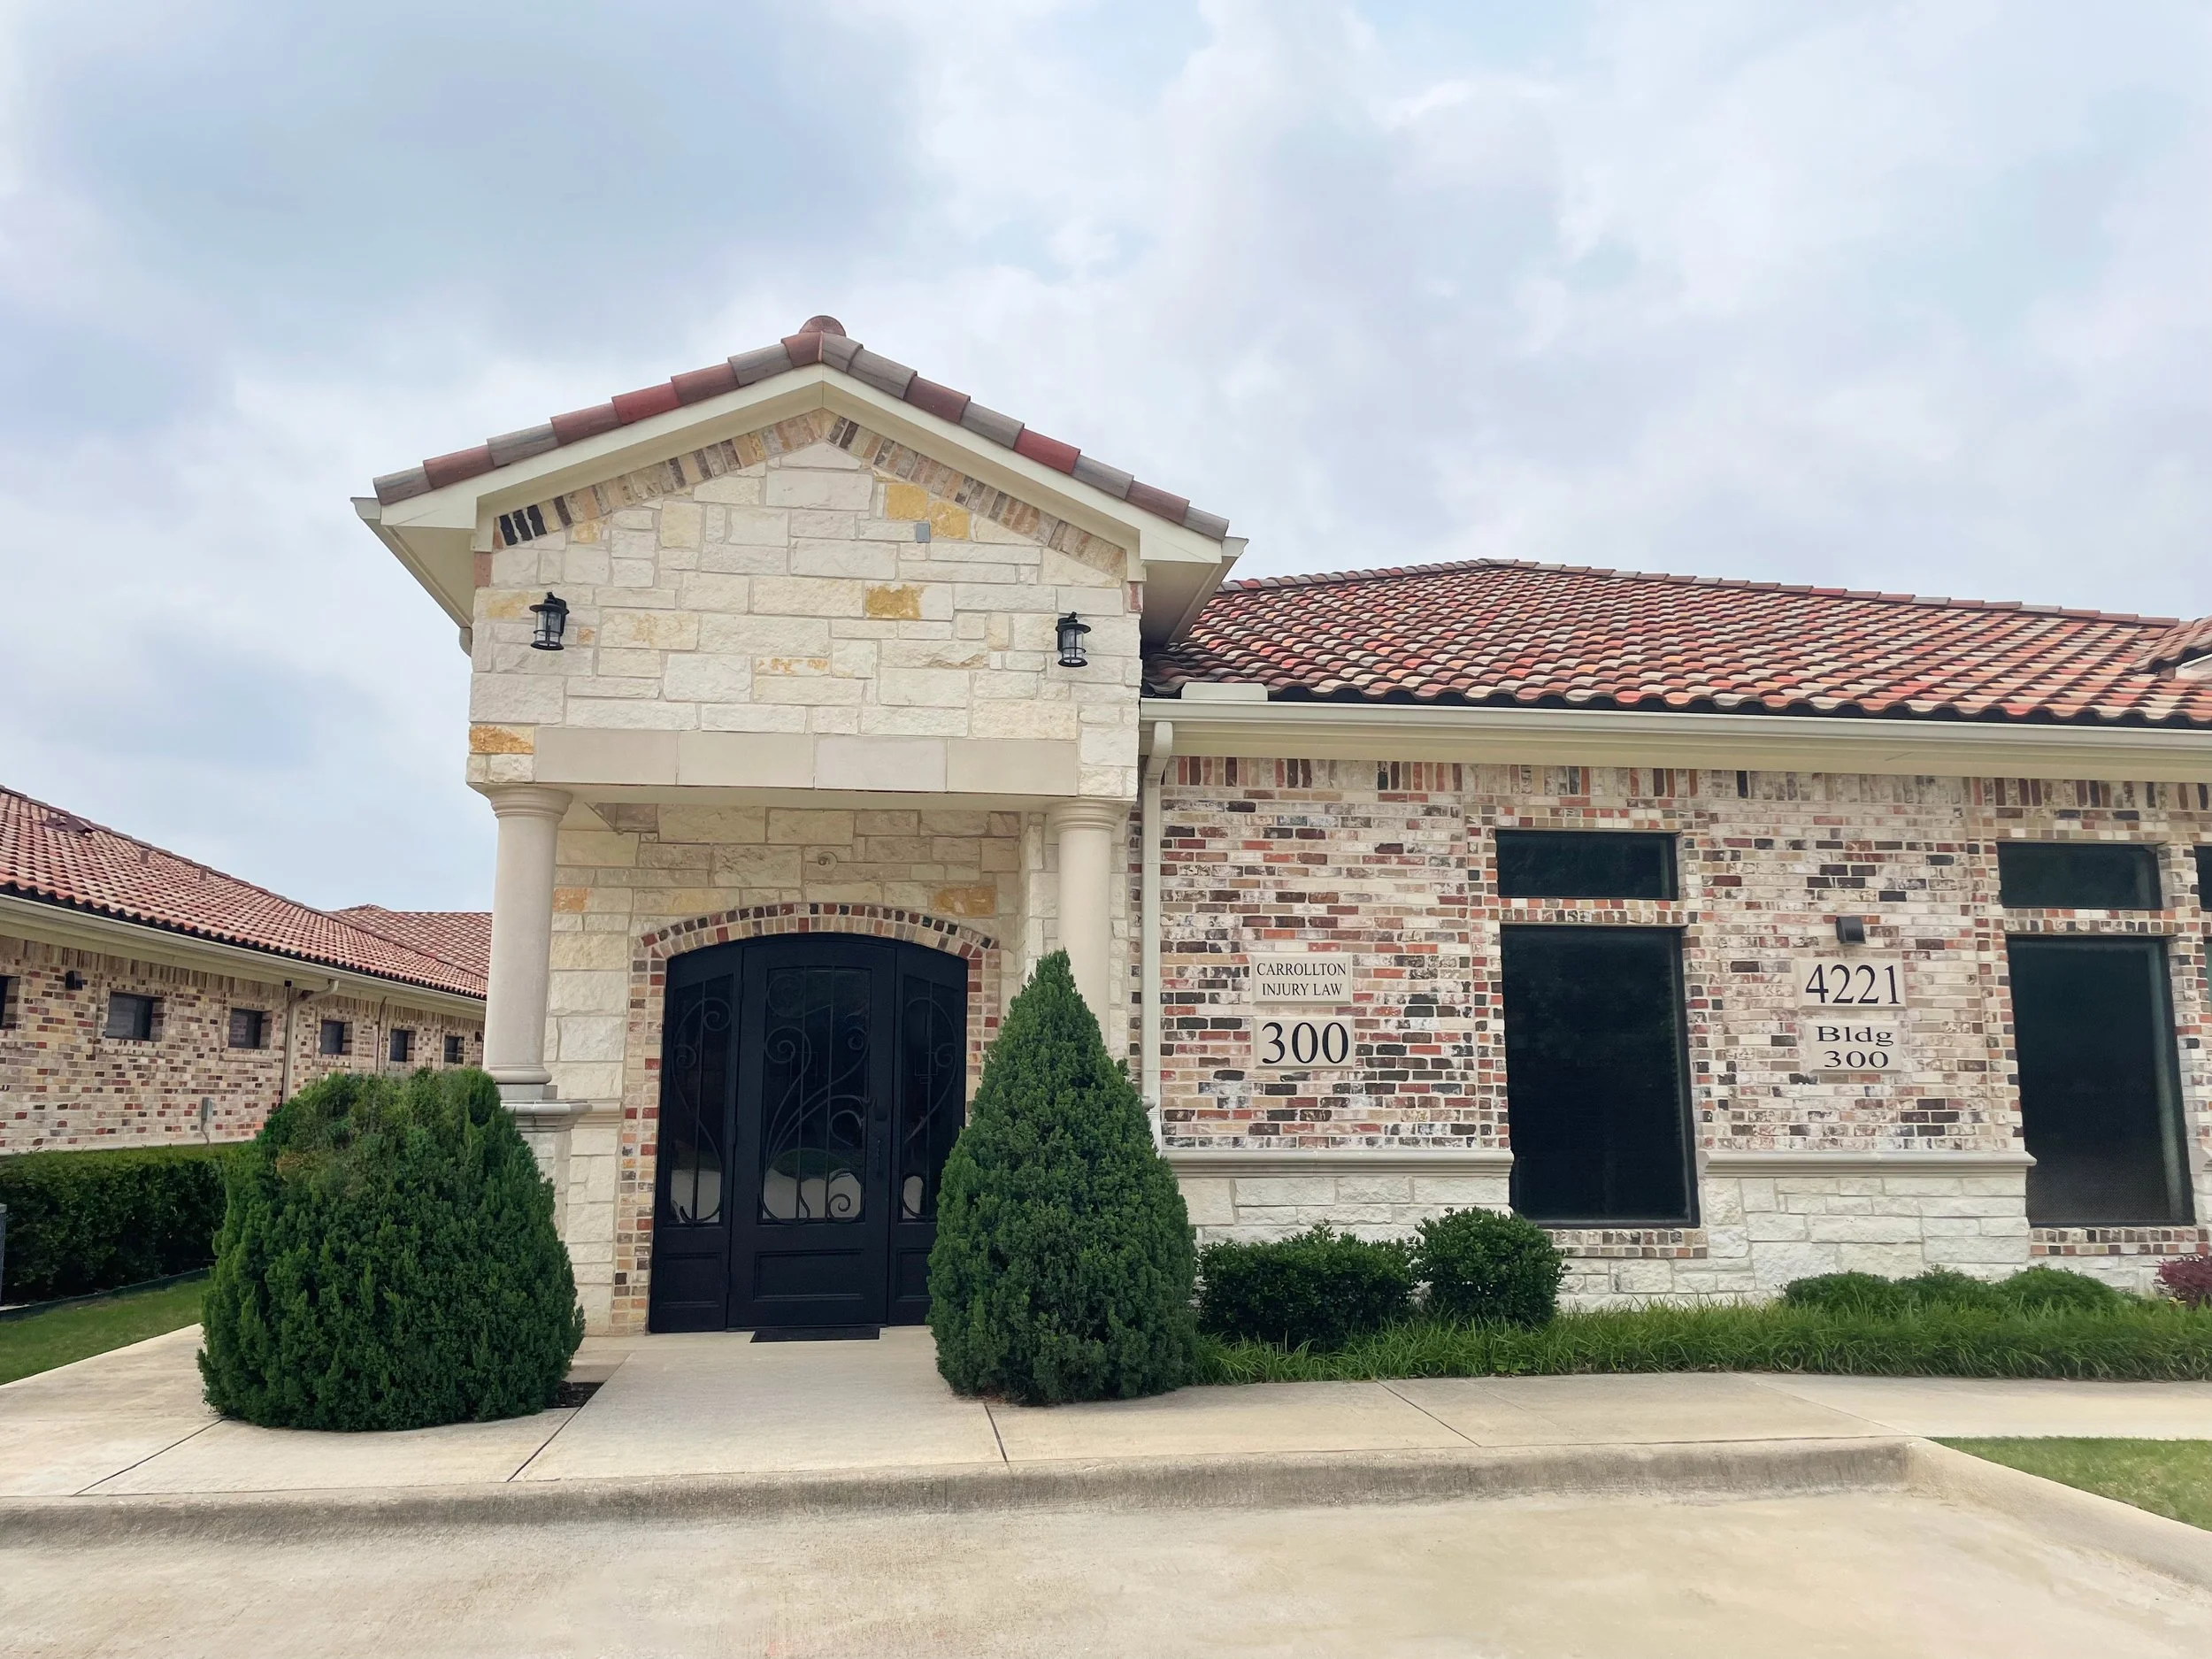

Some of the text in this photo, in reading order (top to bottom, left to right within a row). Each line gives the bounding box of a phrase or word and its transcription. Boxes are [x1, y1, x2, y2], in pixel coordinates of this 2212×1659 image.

[1256, 963, 1346, 976] CARROLLTON
[1262, 983, 1343, 996] INJURY LAW
[1805, 964, 1901, 1004] 4221
[1261, 1021, 1349, 1064] 300
[1816, 1025, 1894, 1048] Bldg
[1823, 1050, 1889, 1069] 300
